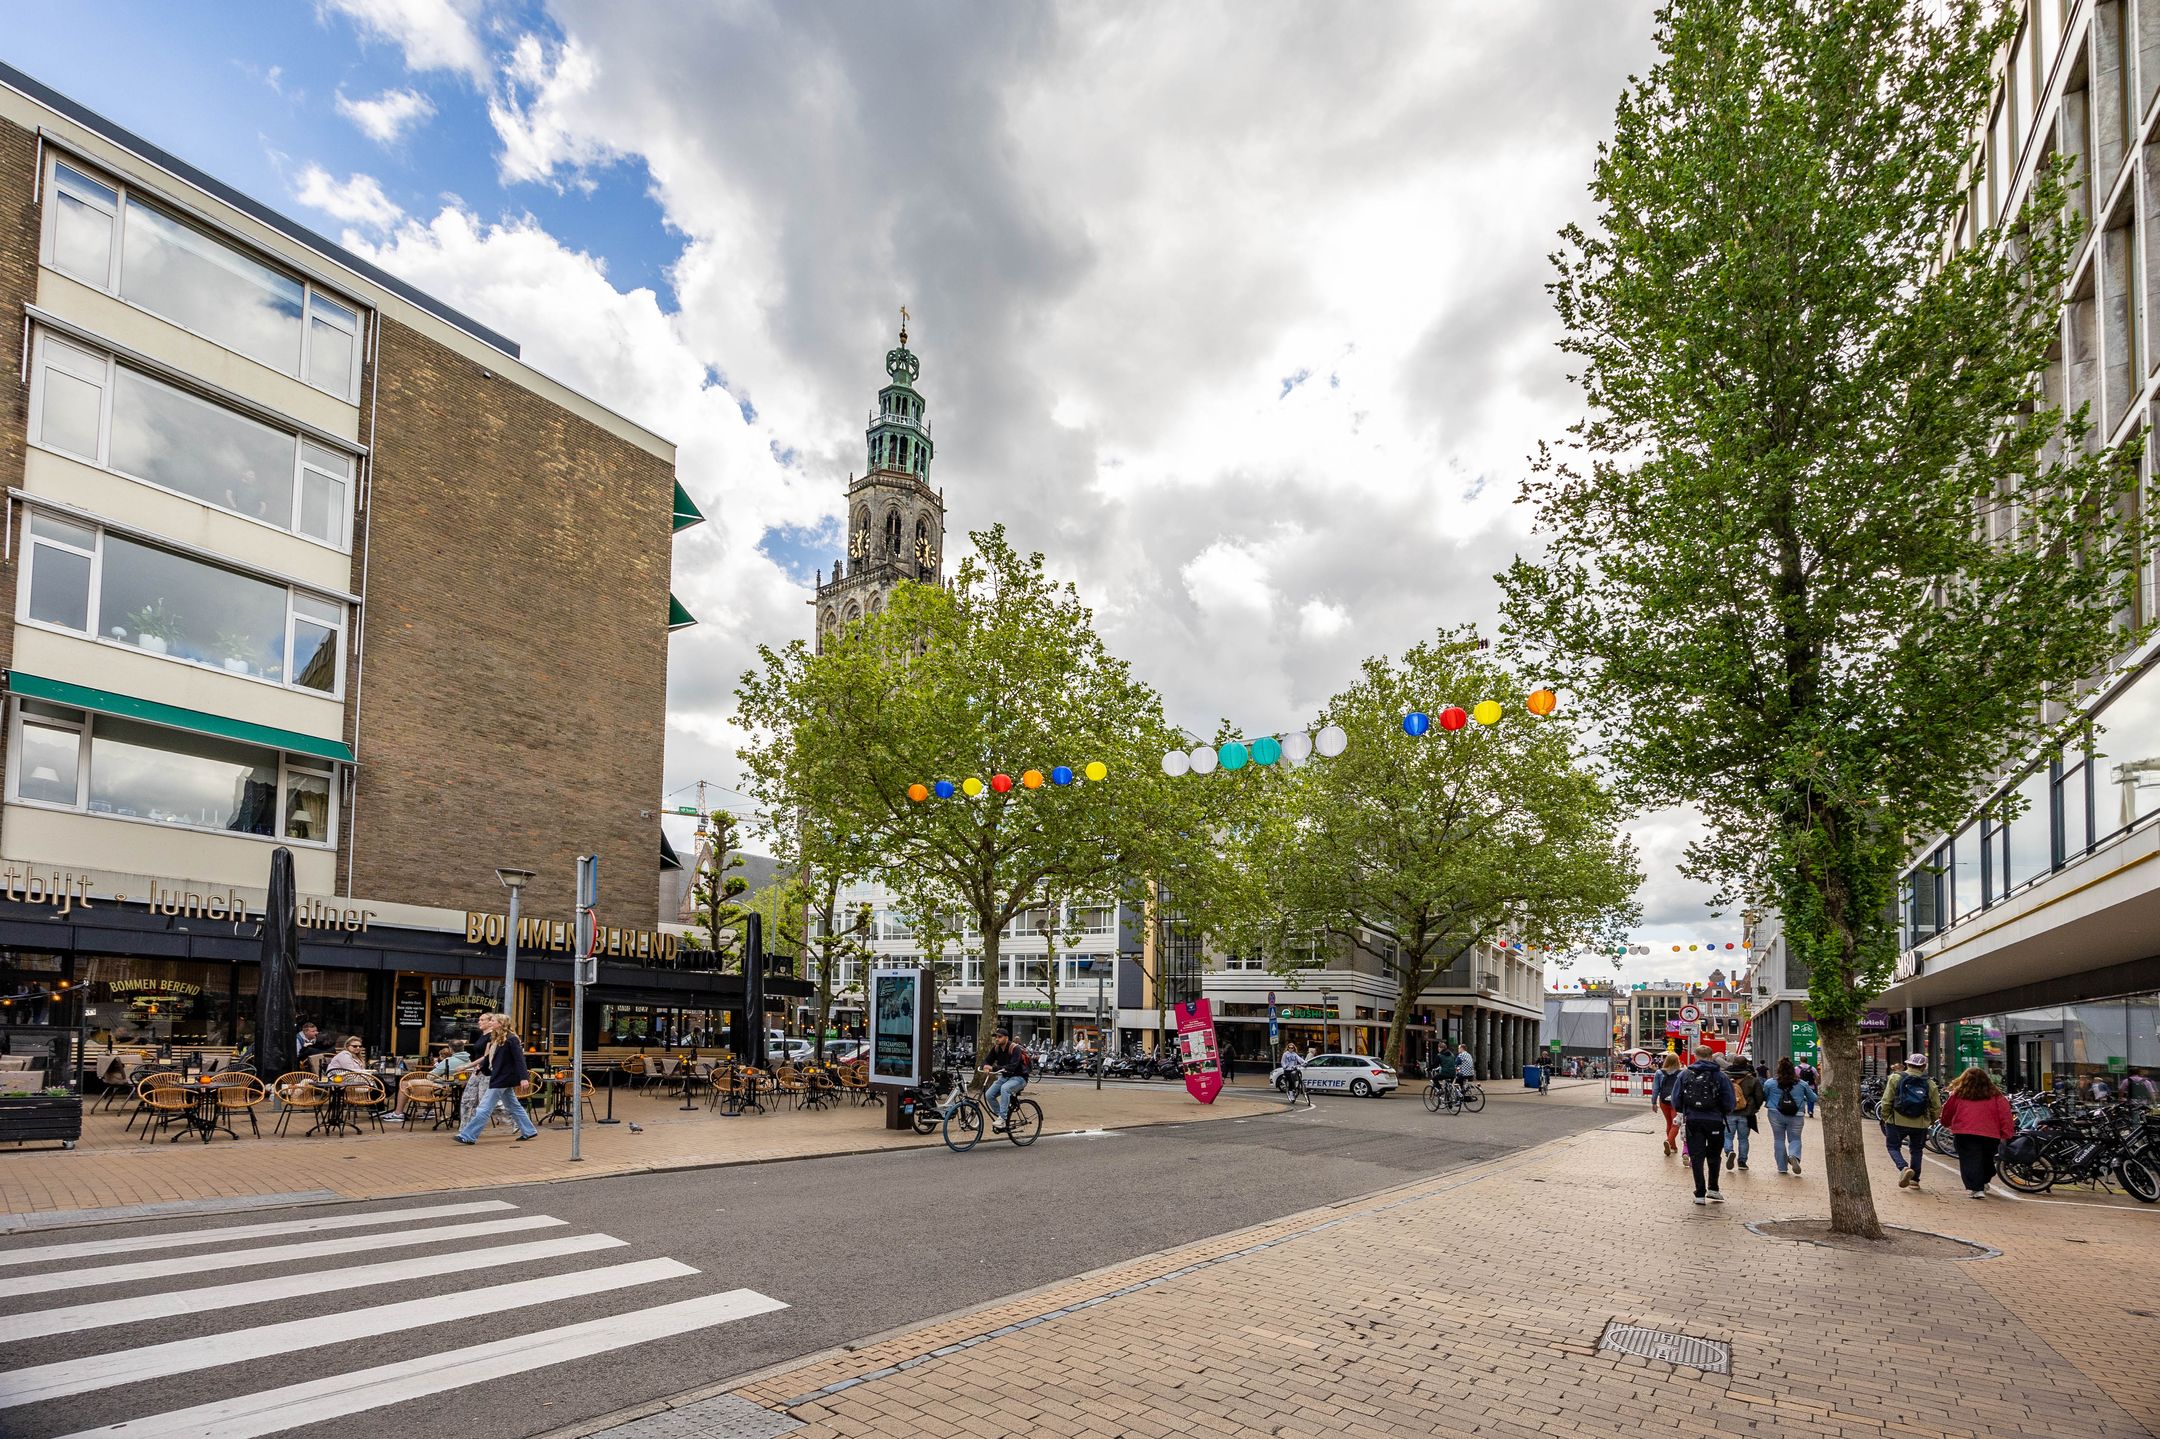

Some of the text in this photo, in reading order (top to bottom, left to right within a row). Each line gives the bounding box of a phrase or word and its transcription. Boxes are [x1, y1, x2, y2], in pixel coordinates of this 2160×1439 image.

[150, 880, 247, 922] lunch
[295, 897, 378, 933] diner
[466, 911, 678, 961] BOMMEN BEREND
[109, 979, 201, 996] BOMMEN BEREND
[440, 995, 498, 1009] BOMMEN BEREND
[1792, 1024, 1800, 1033] P
[1303, 1079, 1346, 1087] EFFEKTIEF
